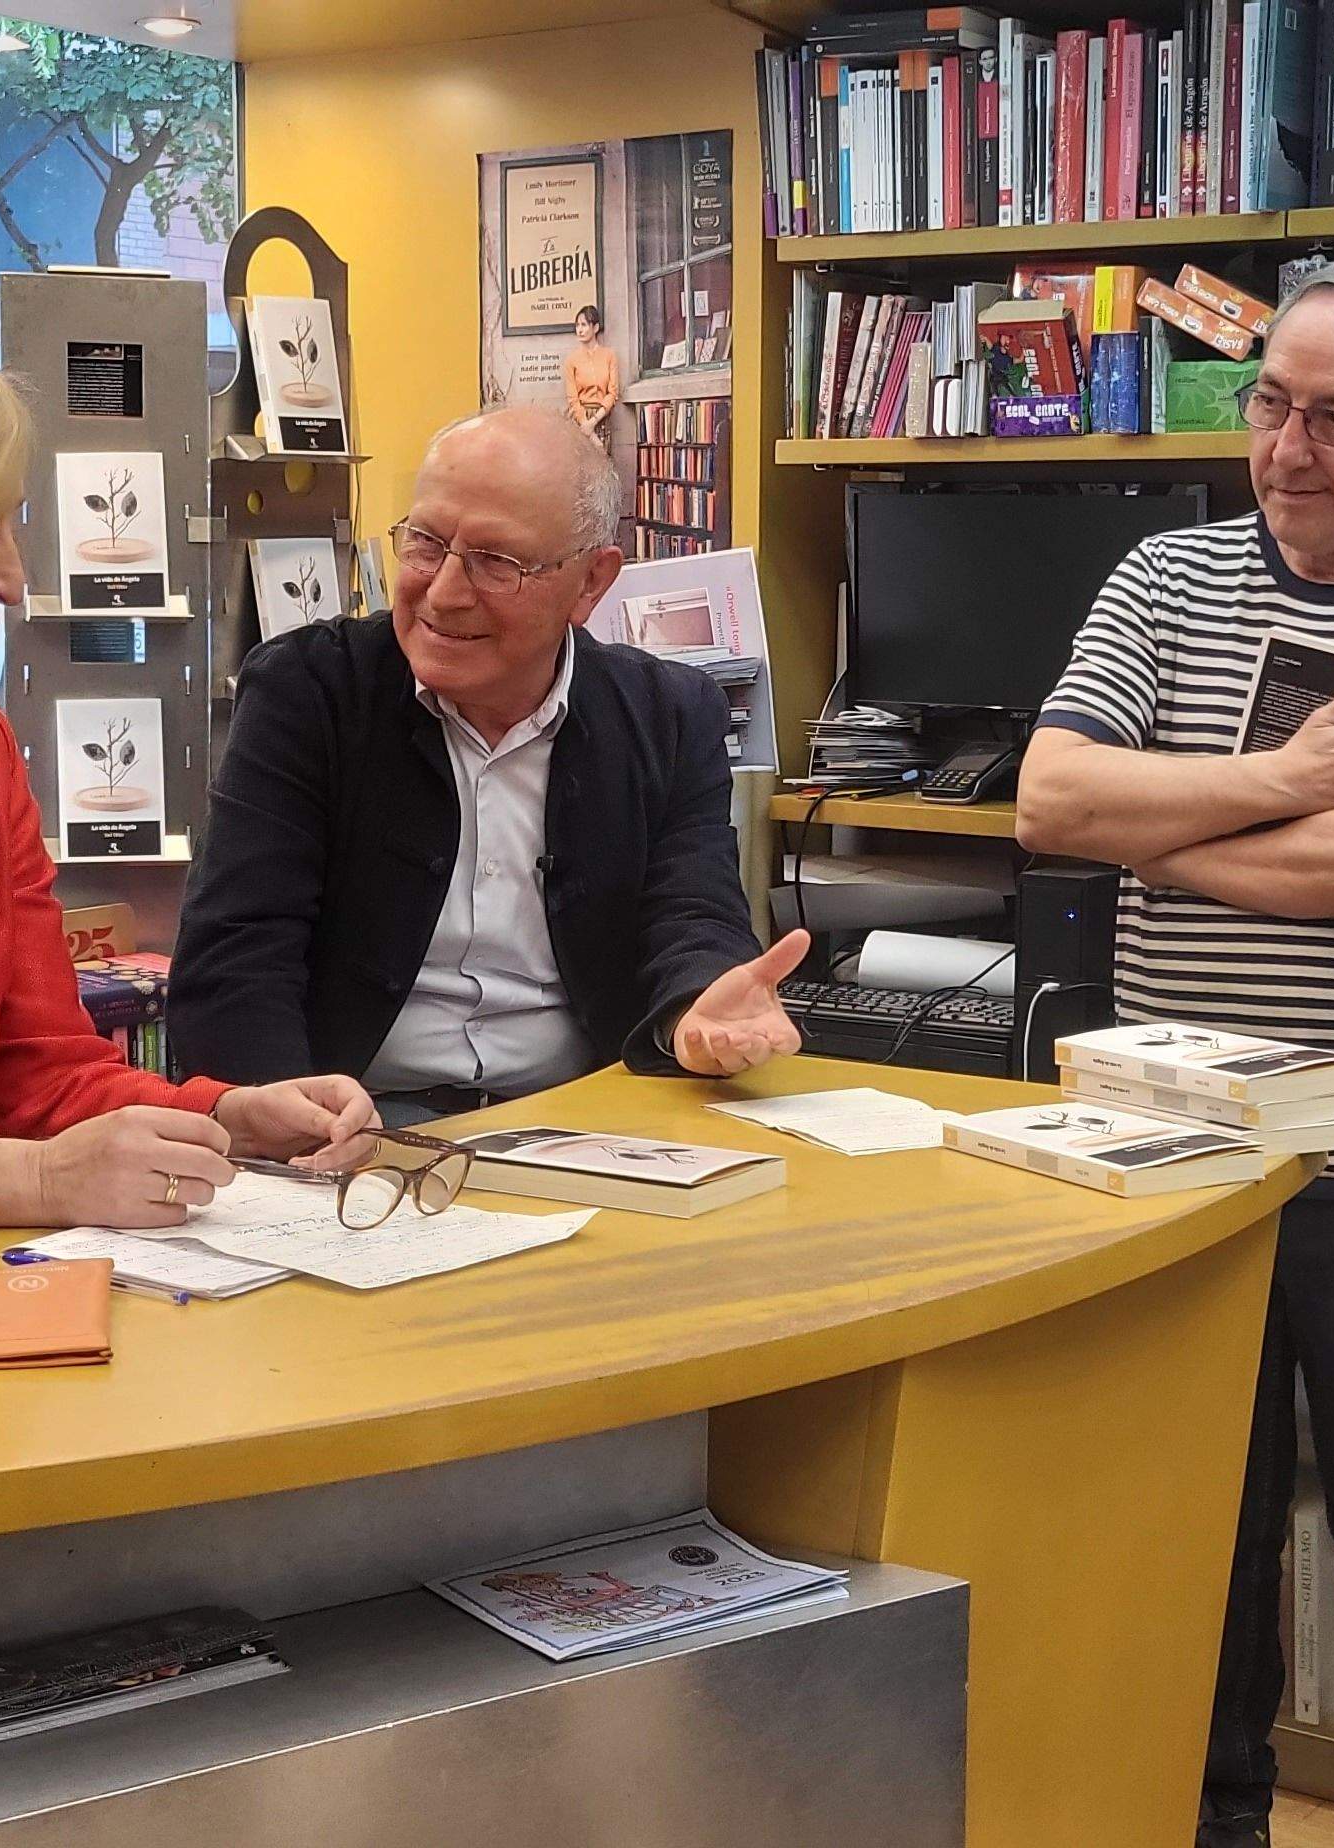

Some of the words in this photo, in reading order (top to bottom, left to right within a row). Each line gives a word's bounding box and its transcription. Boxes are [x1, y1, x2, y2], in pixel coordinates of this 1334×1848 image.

[1183, 77, 1196, 114] Aragón
[1197, 77, 1210, 114] Aragón
[1183, 115, 1194, 128] de
[1198, 115, 1208, 128] de
[1181, 129, 1196, 183] Libertarios
[1196, 129, 1209, 183] Libertarios
[693, 163, 721, 174] GOYA
[545, 179, 576, 189] Mortimer
[521, 215, 546, 224] Patricia
[549, 212, 579, 222] Clarkson
[510, 245, 593, 295] LIBRERÍA
[540, 353, 560, 361] libros
[540, 363, 560, 372] puede
[714, 1571, 766, 1586] 2023
